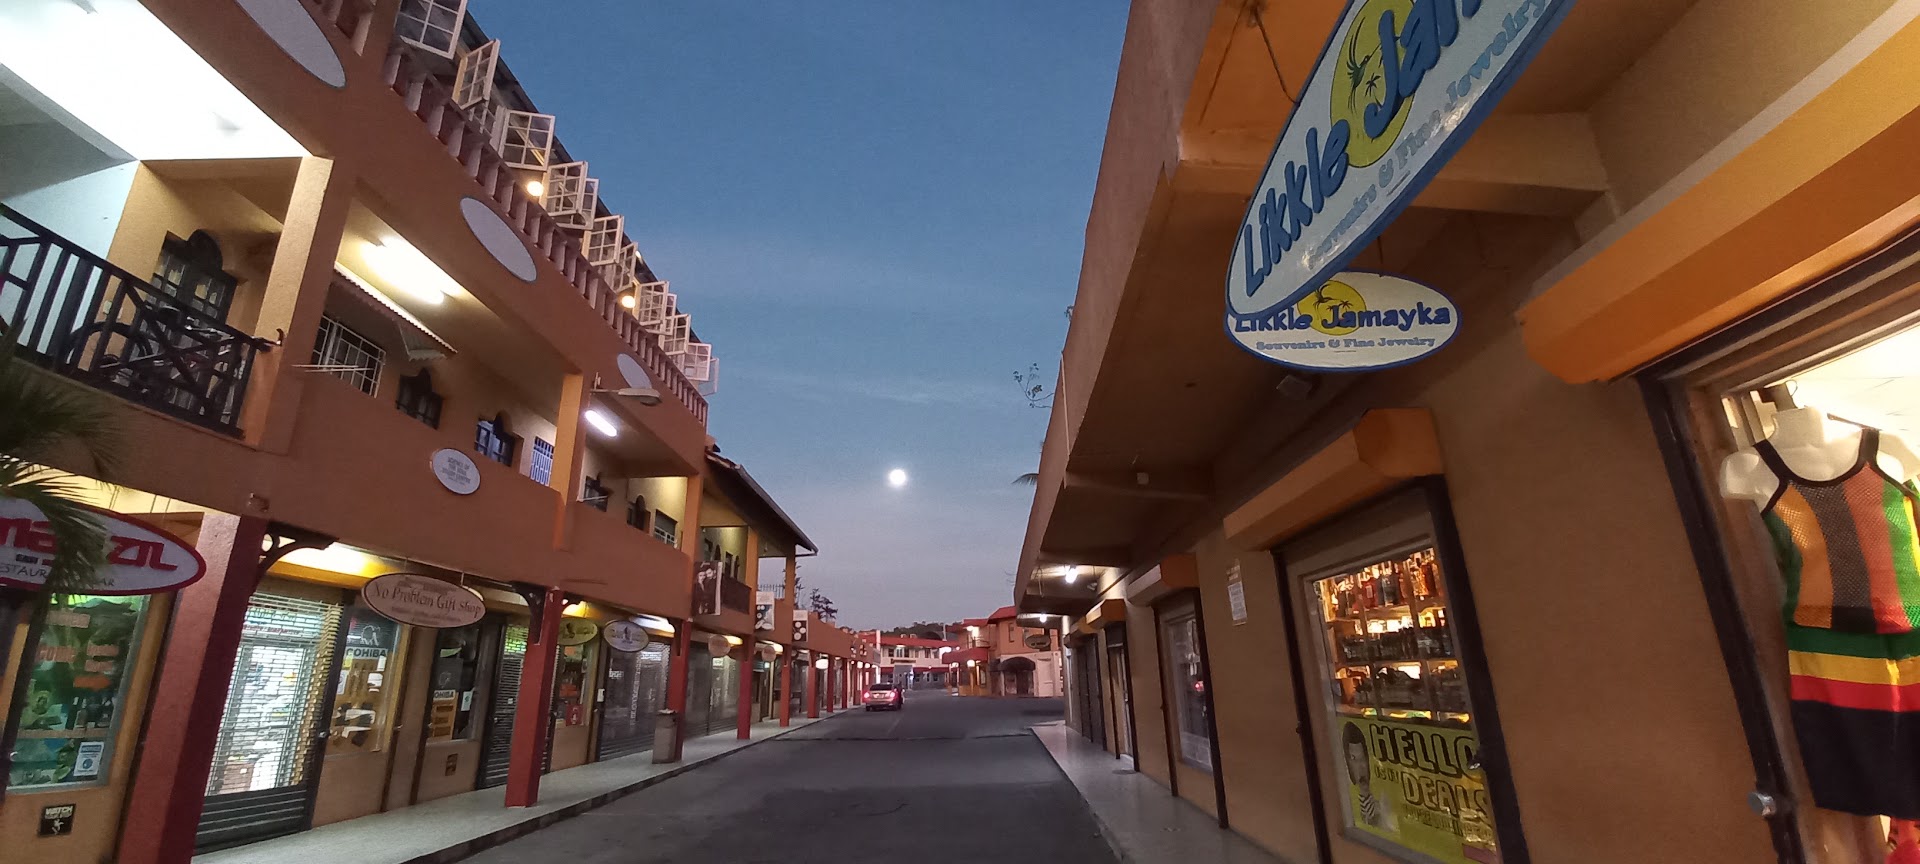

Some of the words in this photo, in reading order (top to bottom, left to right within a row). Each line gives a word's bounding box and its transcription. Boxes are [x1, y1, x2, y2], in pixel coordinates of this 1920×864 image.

[1378, 158, 1394, 189] &
[1243, 118, 1350, 298] Likkle
[1235, 306, 1313, 332] Likkle
[1321, 301, 1451, 332] Jamayka
[1256, 340, 1326, 351] Souvenirs
[1328, 338, 1340, 348] &
[1344, 338, 1375, 348] Fine
[1377, 336, 1436, 348] Jewelry
[436, 594, 457, 614] Gift
[346, 648, 387, 658] COHIBA
[433, 690, 454, 699] OHIBA
[1369, 723, 1482, 784] HELLO
[1400, 770, 1494, 829] DEALS
